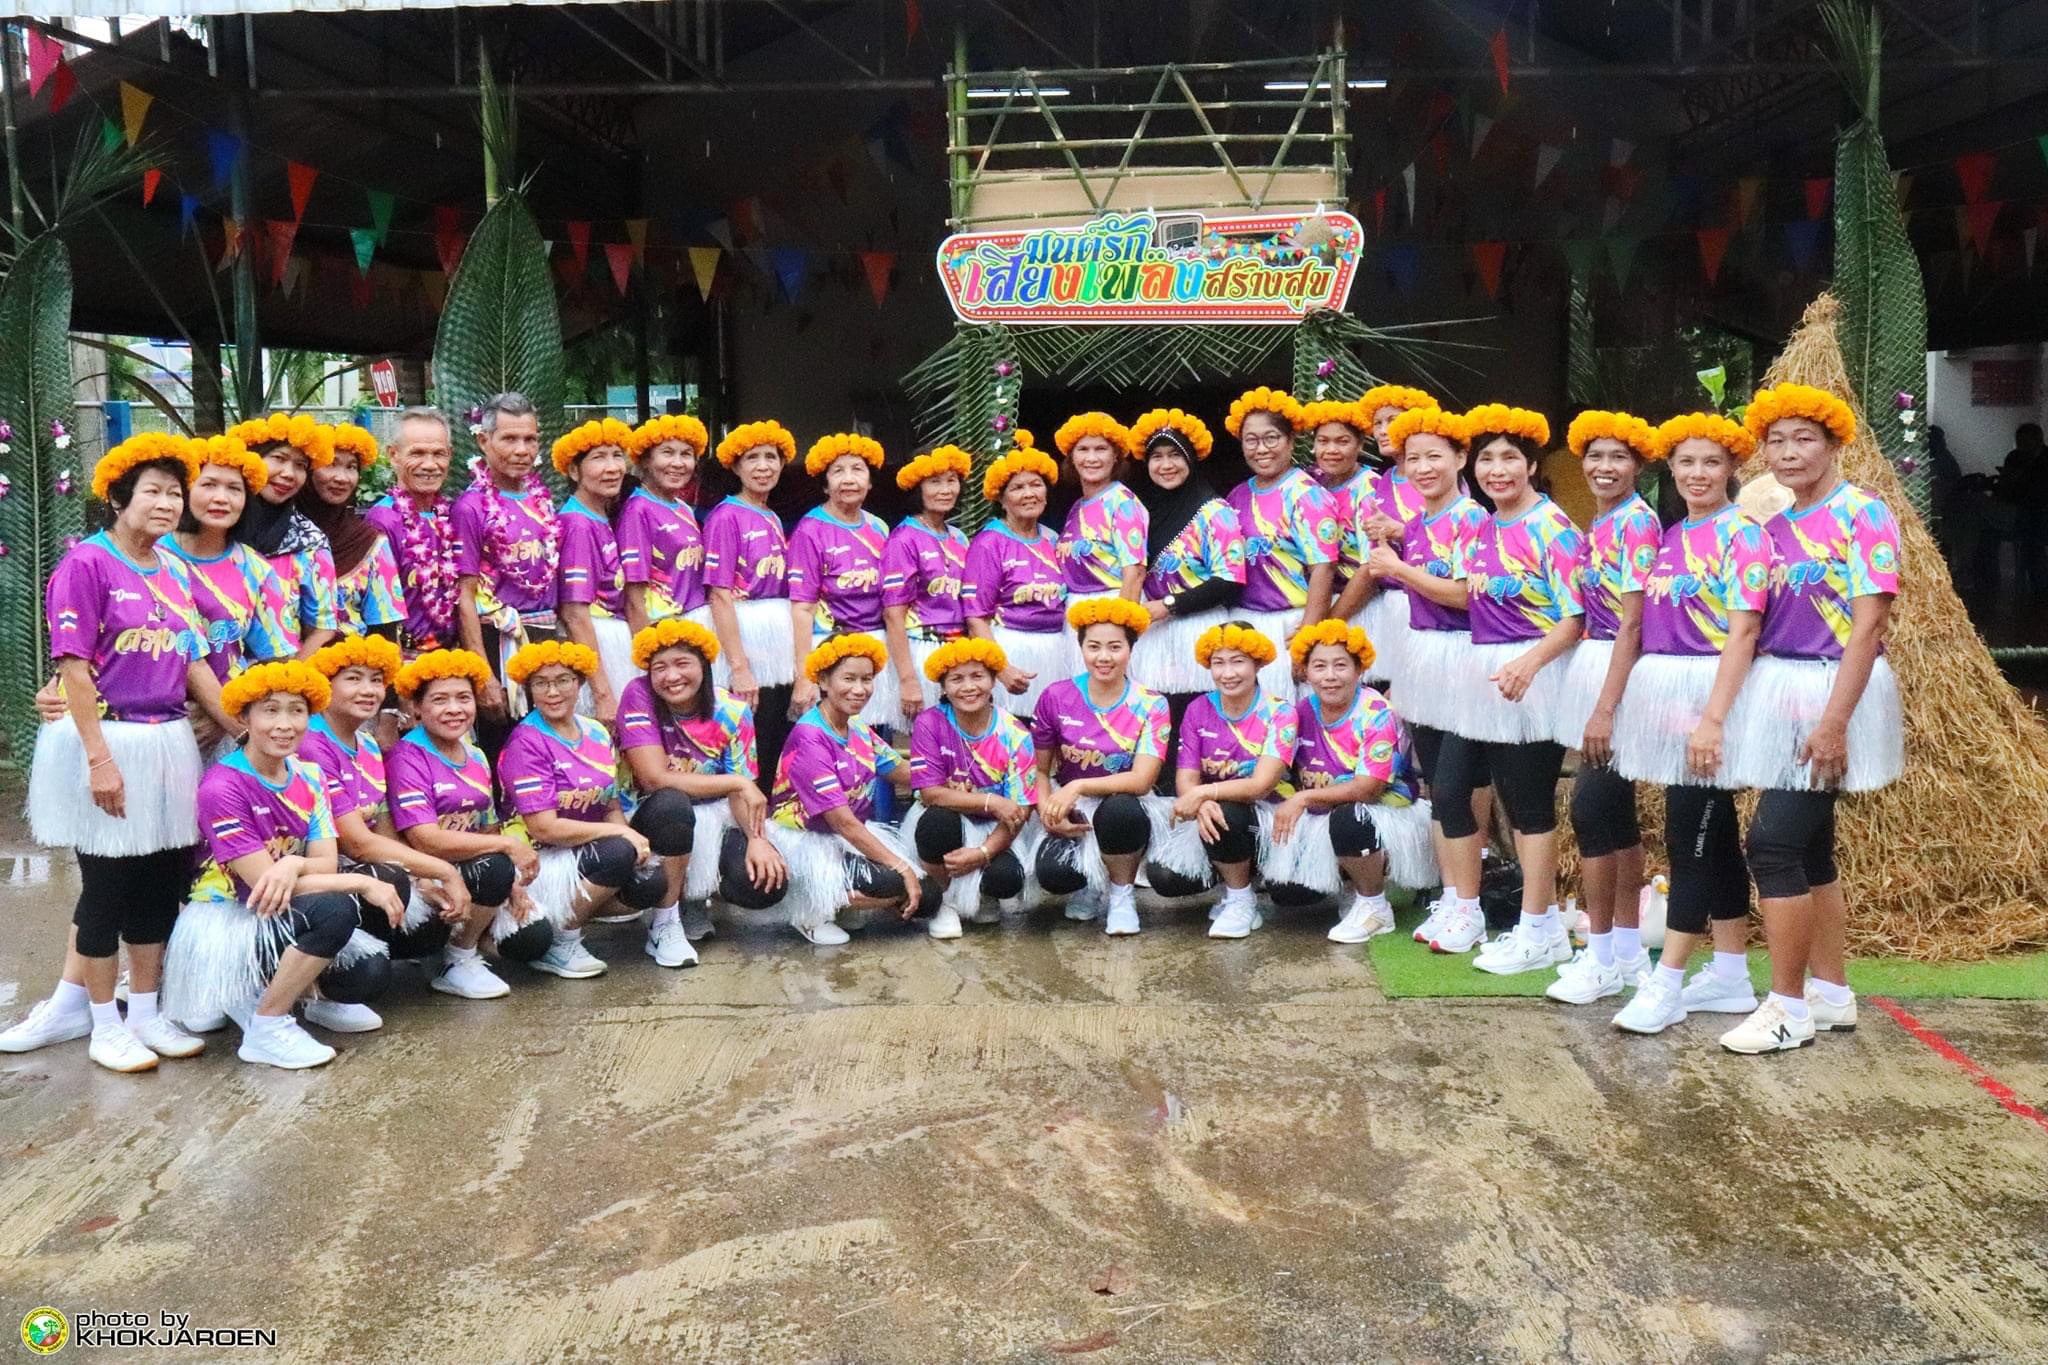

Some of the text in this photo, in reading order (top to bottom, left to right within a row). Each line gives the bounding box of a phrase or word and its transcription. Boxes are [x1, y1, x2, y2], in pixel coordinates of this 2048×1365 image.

[966, 248, 1332, 308] เสียงเพลง สร้างสุข
[1694, 831, 1706, 857] CAMEL
